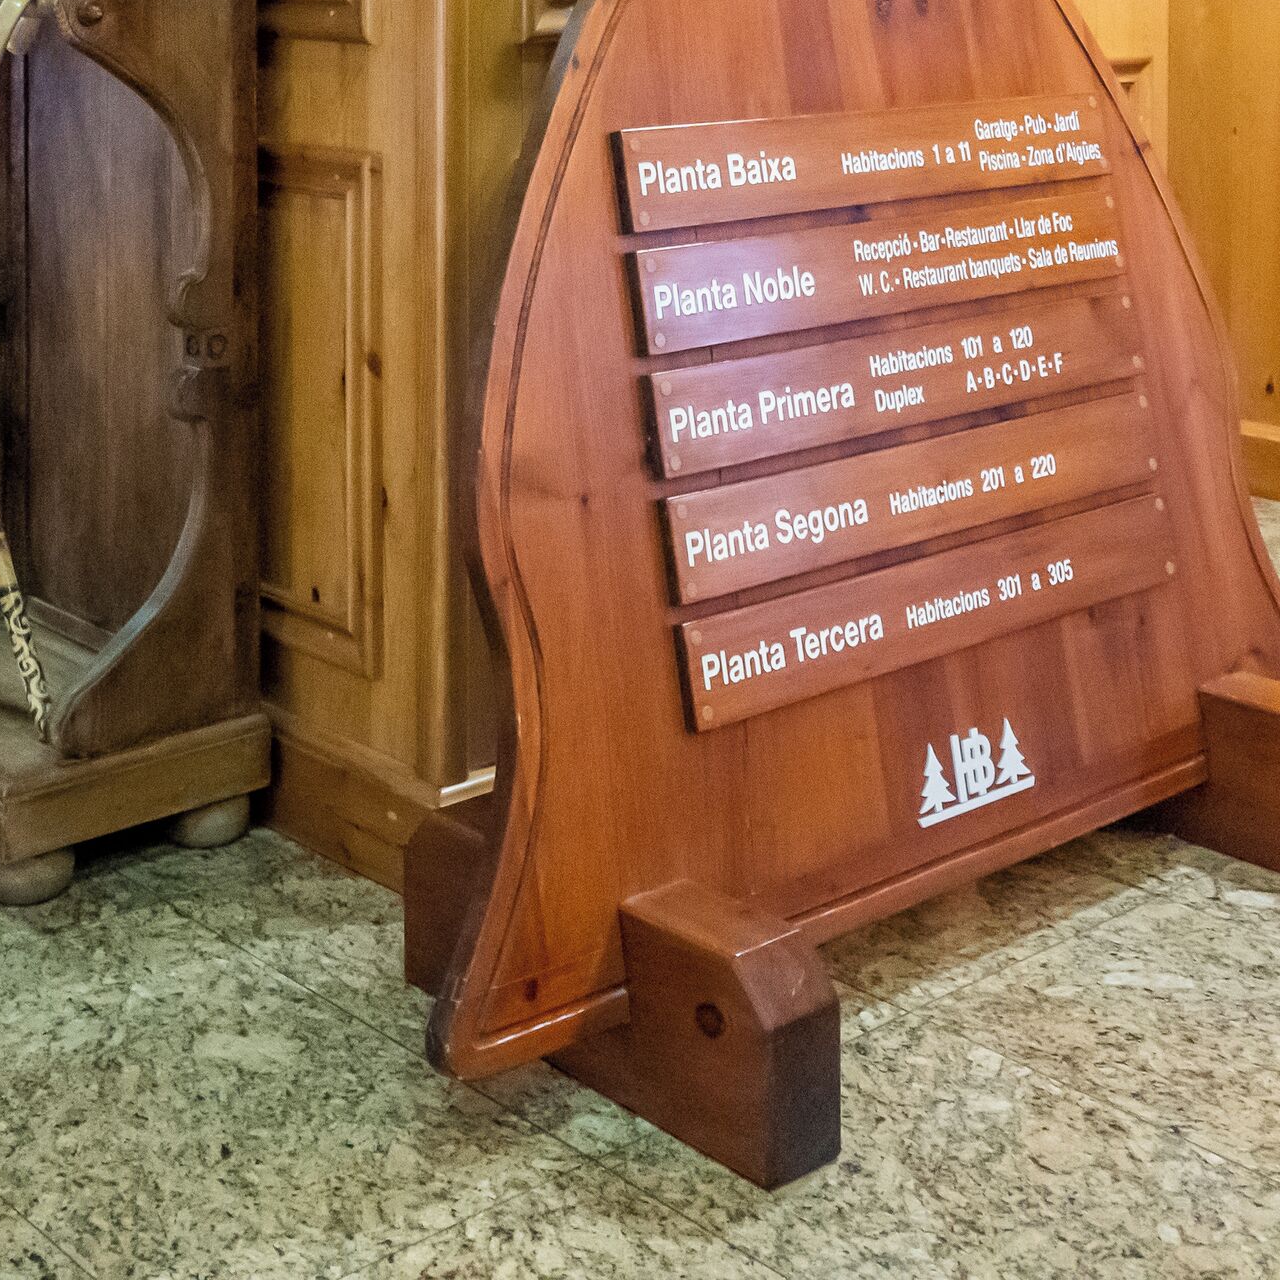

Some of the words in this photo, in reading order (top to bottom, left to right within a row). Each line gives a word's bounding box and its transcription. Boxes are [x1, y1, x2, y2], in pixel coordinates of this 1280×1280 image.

[974, 118, 1019, 141] Garatge
[1024, 113, 1047, 135] Pub
[1053, 110, 1081, 132] Jardí
[638, 159, 722, 196] Planta
[726, 150, 797, 187] Baixa
[841, 147, 925, 174] Habitacions
[932, 144, 941, 165] 1
[945, 147, 955, 163] a
[959, 141, 971, 161] 11
[979, 149, 1021, 171] Piscina
[1026, 146, 1055, 167] Zona
[1056, 141, 1101, 165] d'Aigües
[853, 233, 912, 262] Recepció
[1014, 217, 1036, 239] Llar
[1038, 214, 1051, 235] de
[1052, 211, 1073, 233] Foc
[902, 261, 968, 289] Restaurant
[968, 252, 1022, 279] banquets
[1028, 247, 1053, 269] Sala
[1054, 244, 1068, 265] de
[1069, 238, 1119, 261] Reunions
[654, 279, 738, 319] Planta
[743, 265, 816, 305] Noble
[869, 343, 953, 378] Habitacions
[960, 336, 984, 359] 101
[993, 337, 1003, 353] a
[1008, 325, 1033, 350] 120
[669, 398, 754, 442] Planta
[758, 381, 856, 425] Primera
[874, 384, 925, 413] Duplex
[685, 520, 770, 568] Planta
[775, 498, 869, 544] Segona
[888, 476, 973, 516] Habitacions
[980, 466, 1005, 493] 201
[1014, 466, 1025, 484] a
[1030, 453, 1056, 480] 220
[701, 640, 786, 690] Planta
[790, 613, 883, 663] Tercera
[906, 584, 990, 630] Habitacions
[997, 575, 1023, 601] 301
[1031, 574, 1041, 591] a
[1047, 559, 1074, 585] 305
